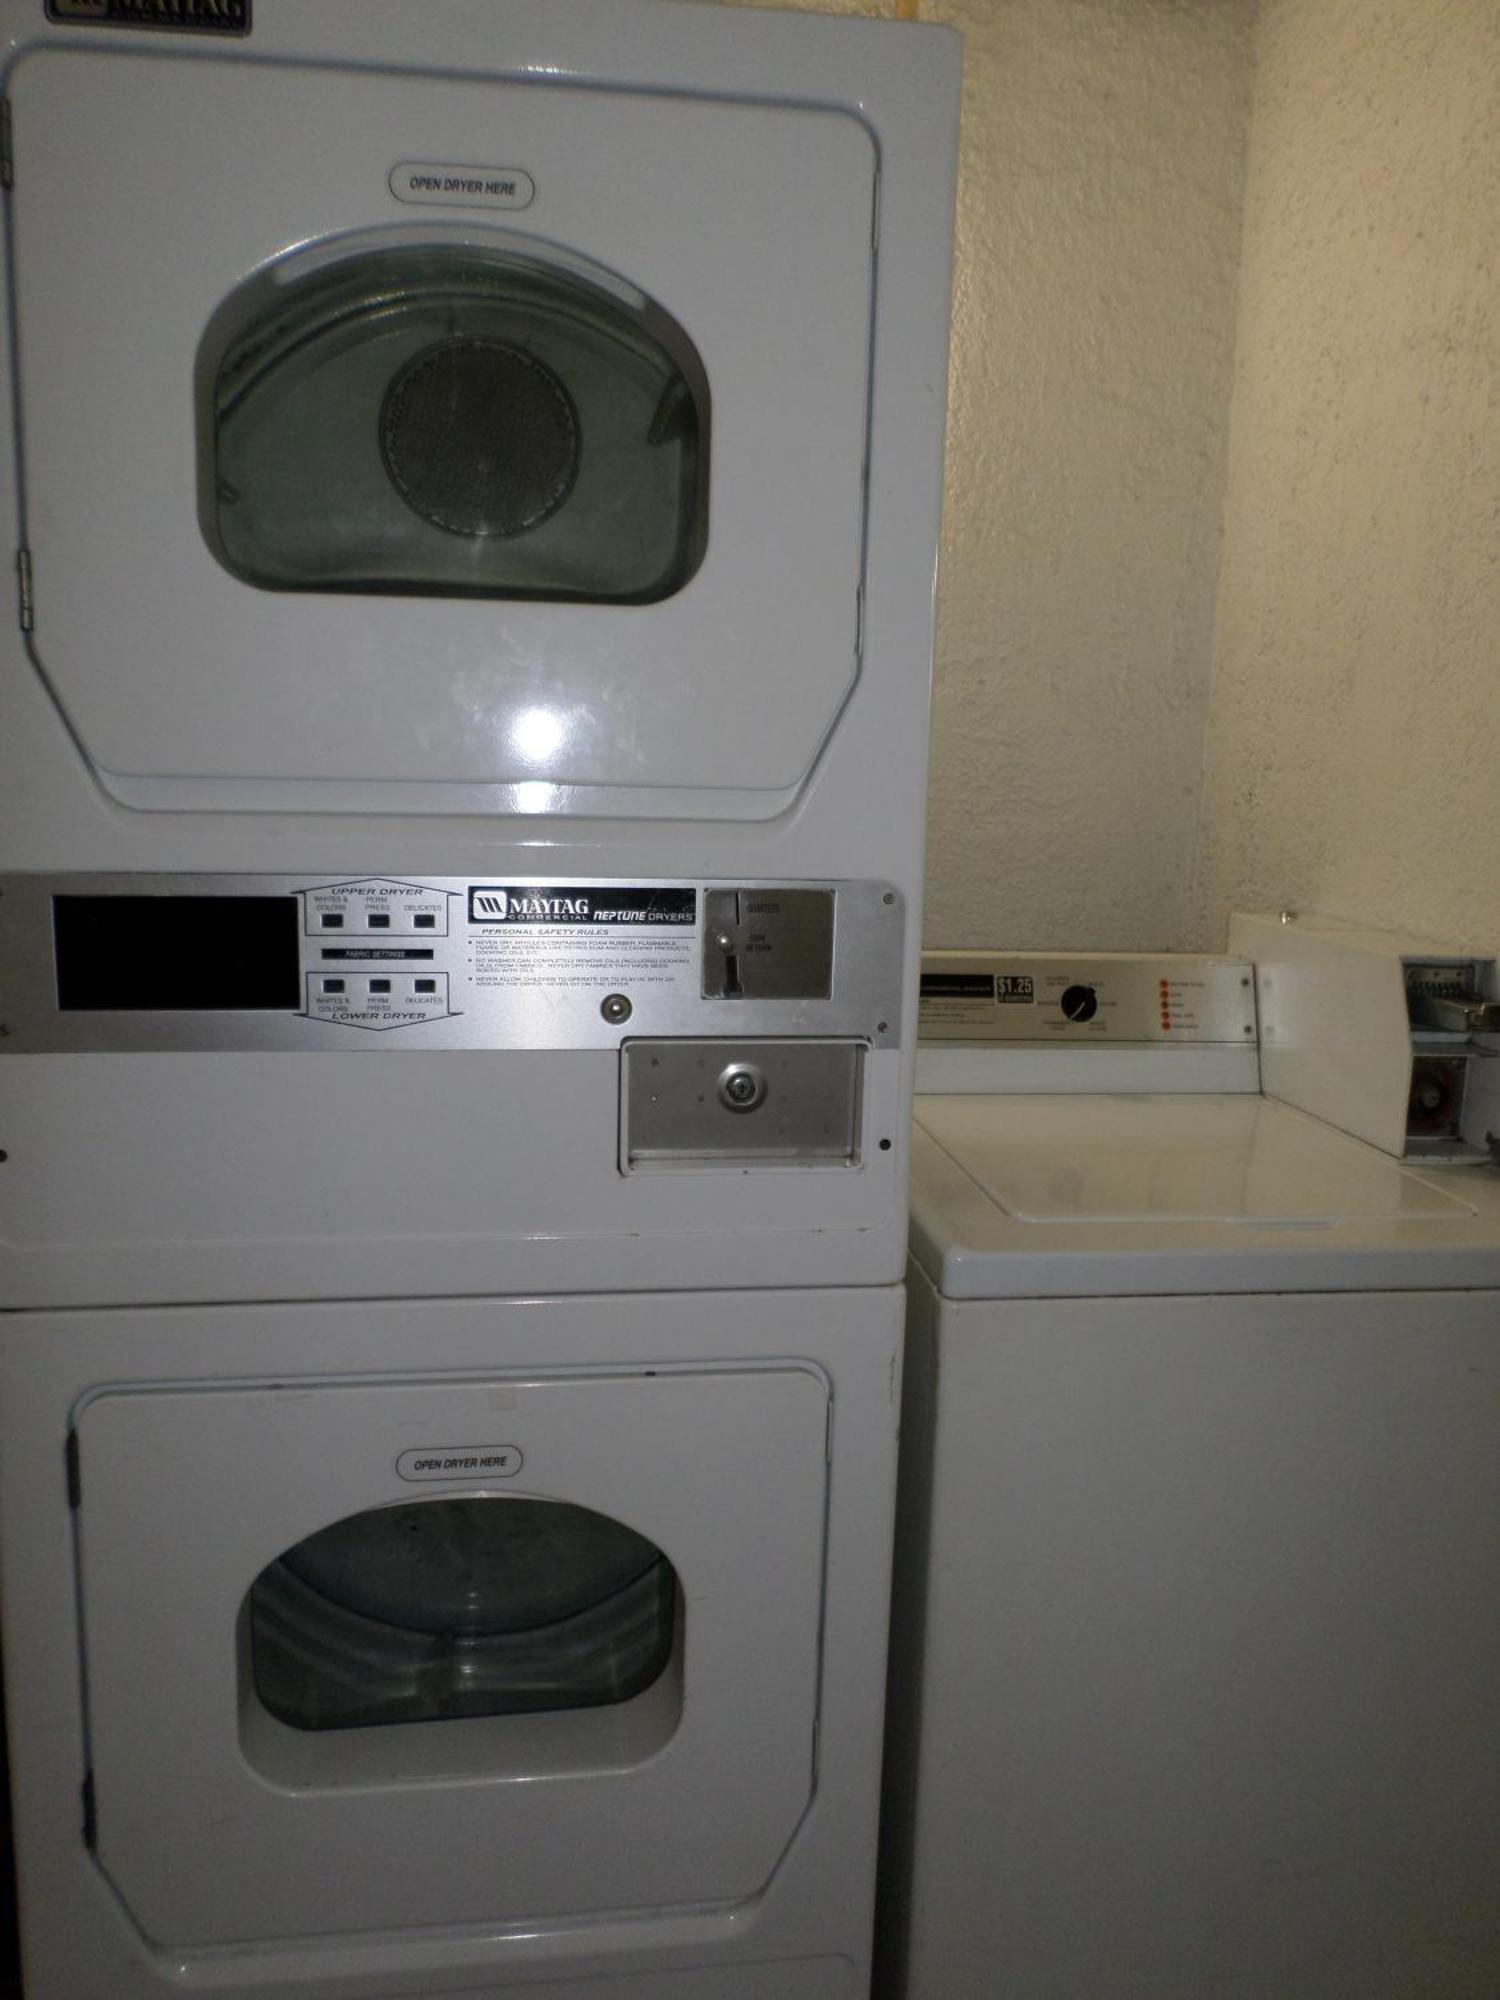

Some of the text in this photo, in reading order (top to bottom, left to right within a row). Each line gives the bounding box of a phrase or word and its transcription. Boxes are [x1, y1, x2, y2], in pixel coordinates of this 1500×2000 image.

[409, 176, 517, 196] OPEN DRYER HERE
[332, 888, 424, 896] UPPER DRYER
[509, 898, 590, 914] MAYTAG
[593, 911, 647, 921] NEPTUNE
[647, 912, 693, 921] DRYERS
[482, 928, 609, 936] PERSONAL SAFETY RULES
[372, 950, 406, 959] SETTINGS
[998, 978, 1032, 993] $1.25
[332, 1012, 426, 1020] LOWER DRYER
[414, 1456, 508, 1471] OPEN DRYER HERE
